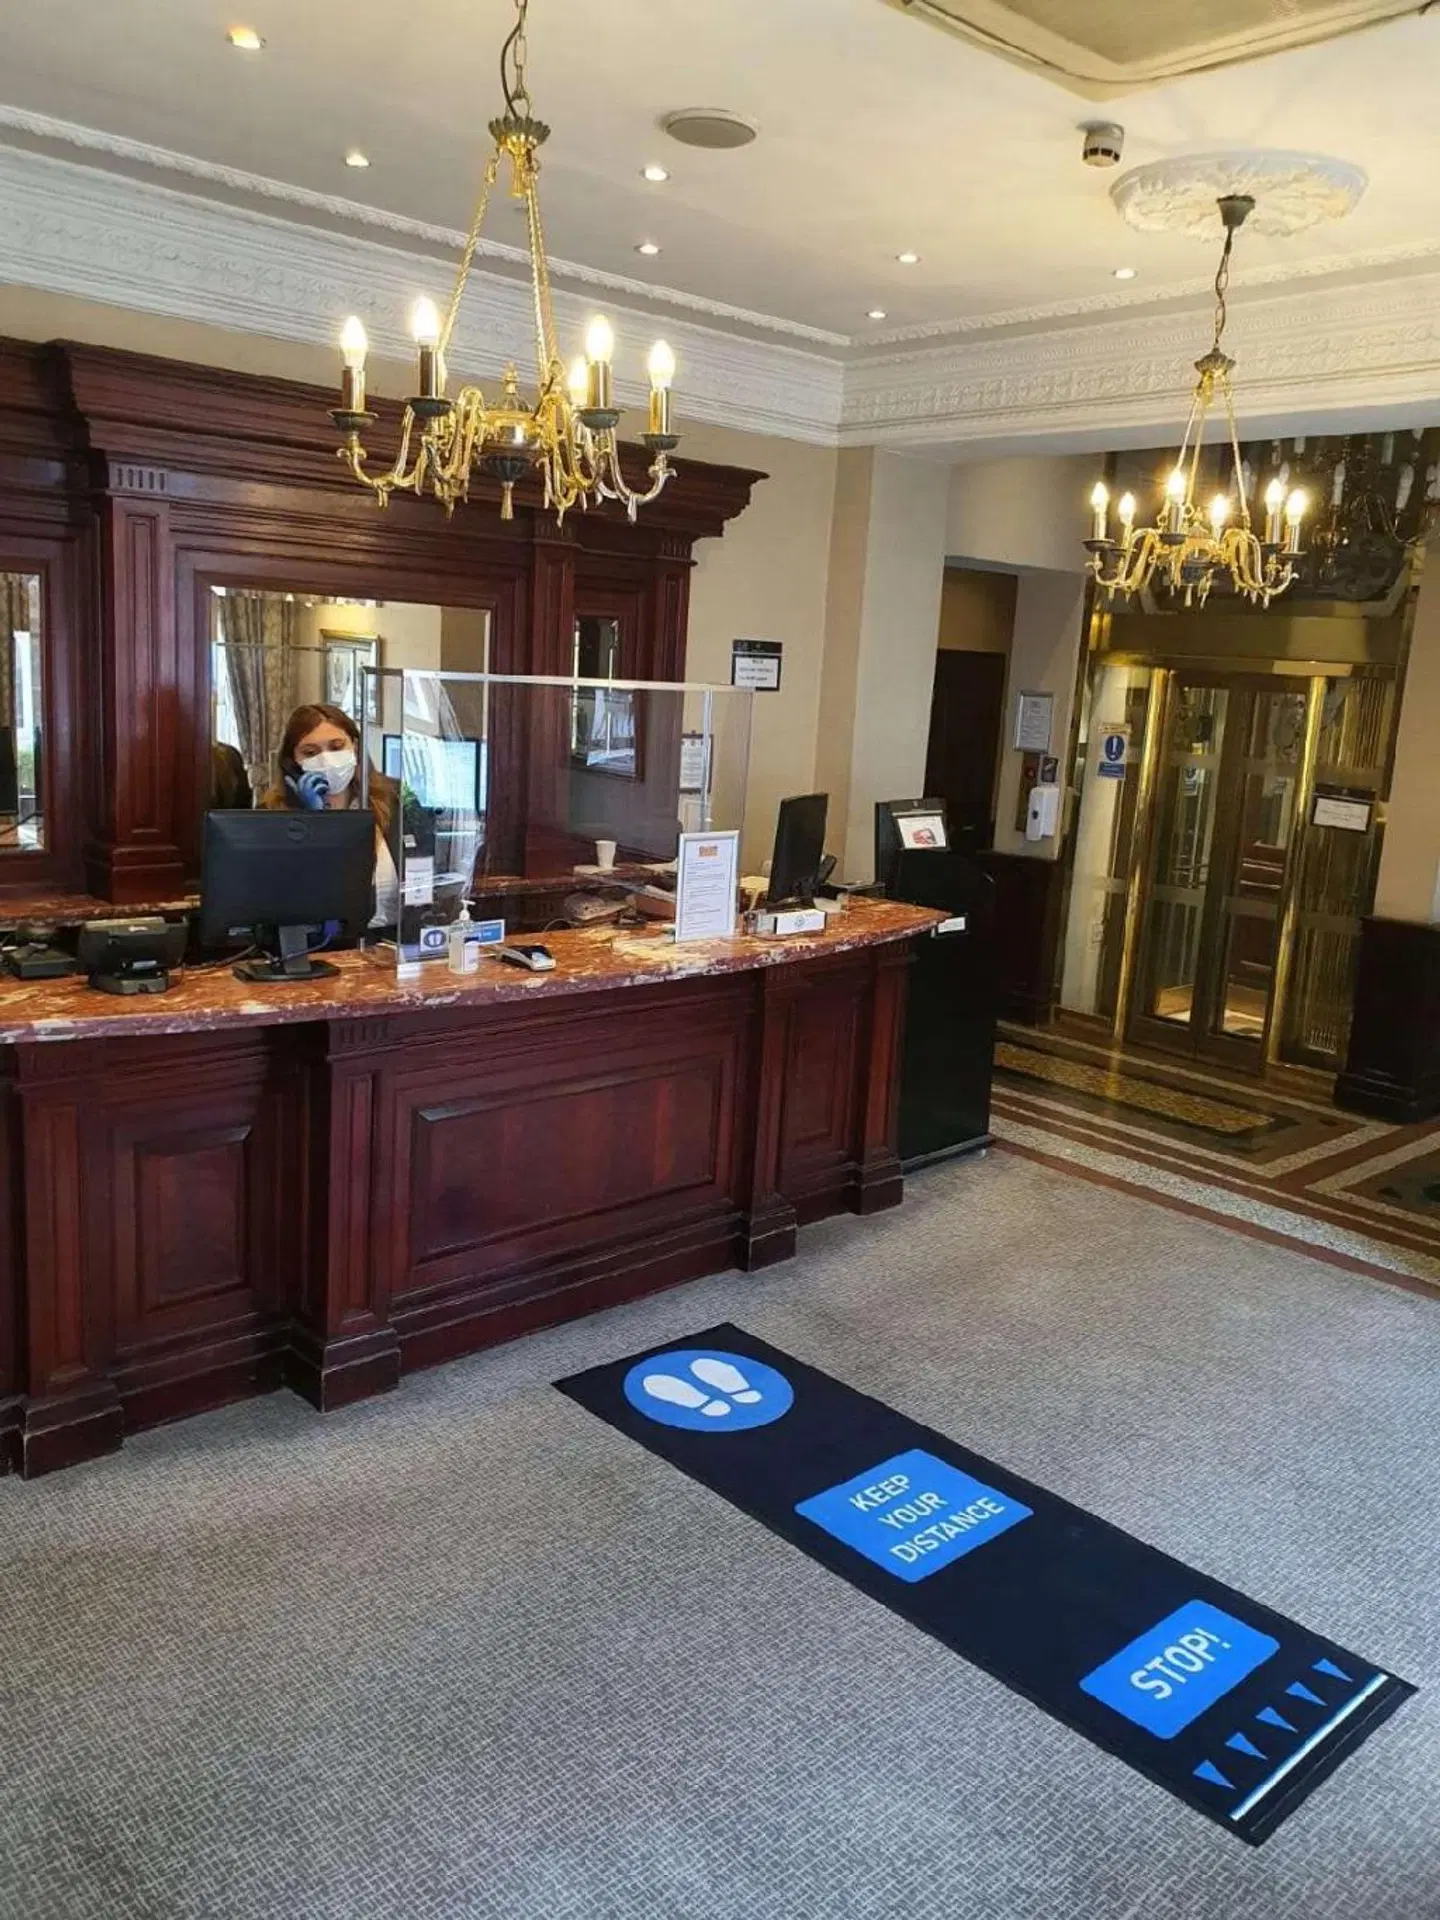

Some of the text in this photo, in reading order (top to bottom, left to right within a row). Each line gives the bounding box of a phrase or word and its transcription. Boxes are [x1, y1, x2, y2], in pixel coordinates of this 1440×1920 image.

[850, 1474, 911, 1512] KEEP
[878, 1491, 948, 1530] YOUR
[889, 1497, 1005, 1563] DISTANCE
[1130, 1627, 1232, 1700] STOP!
